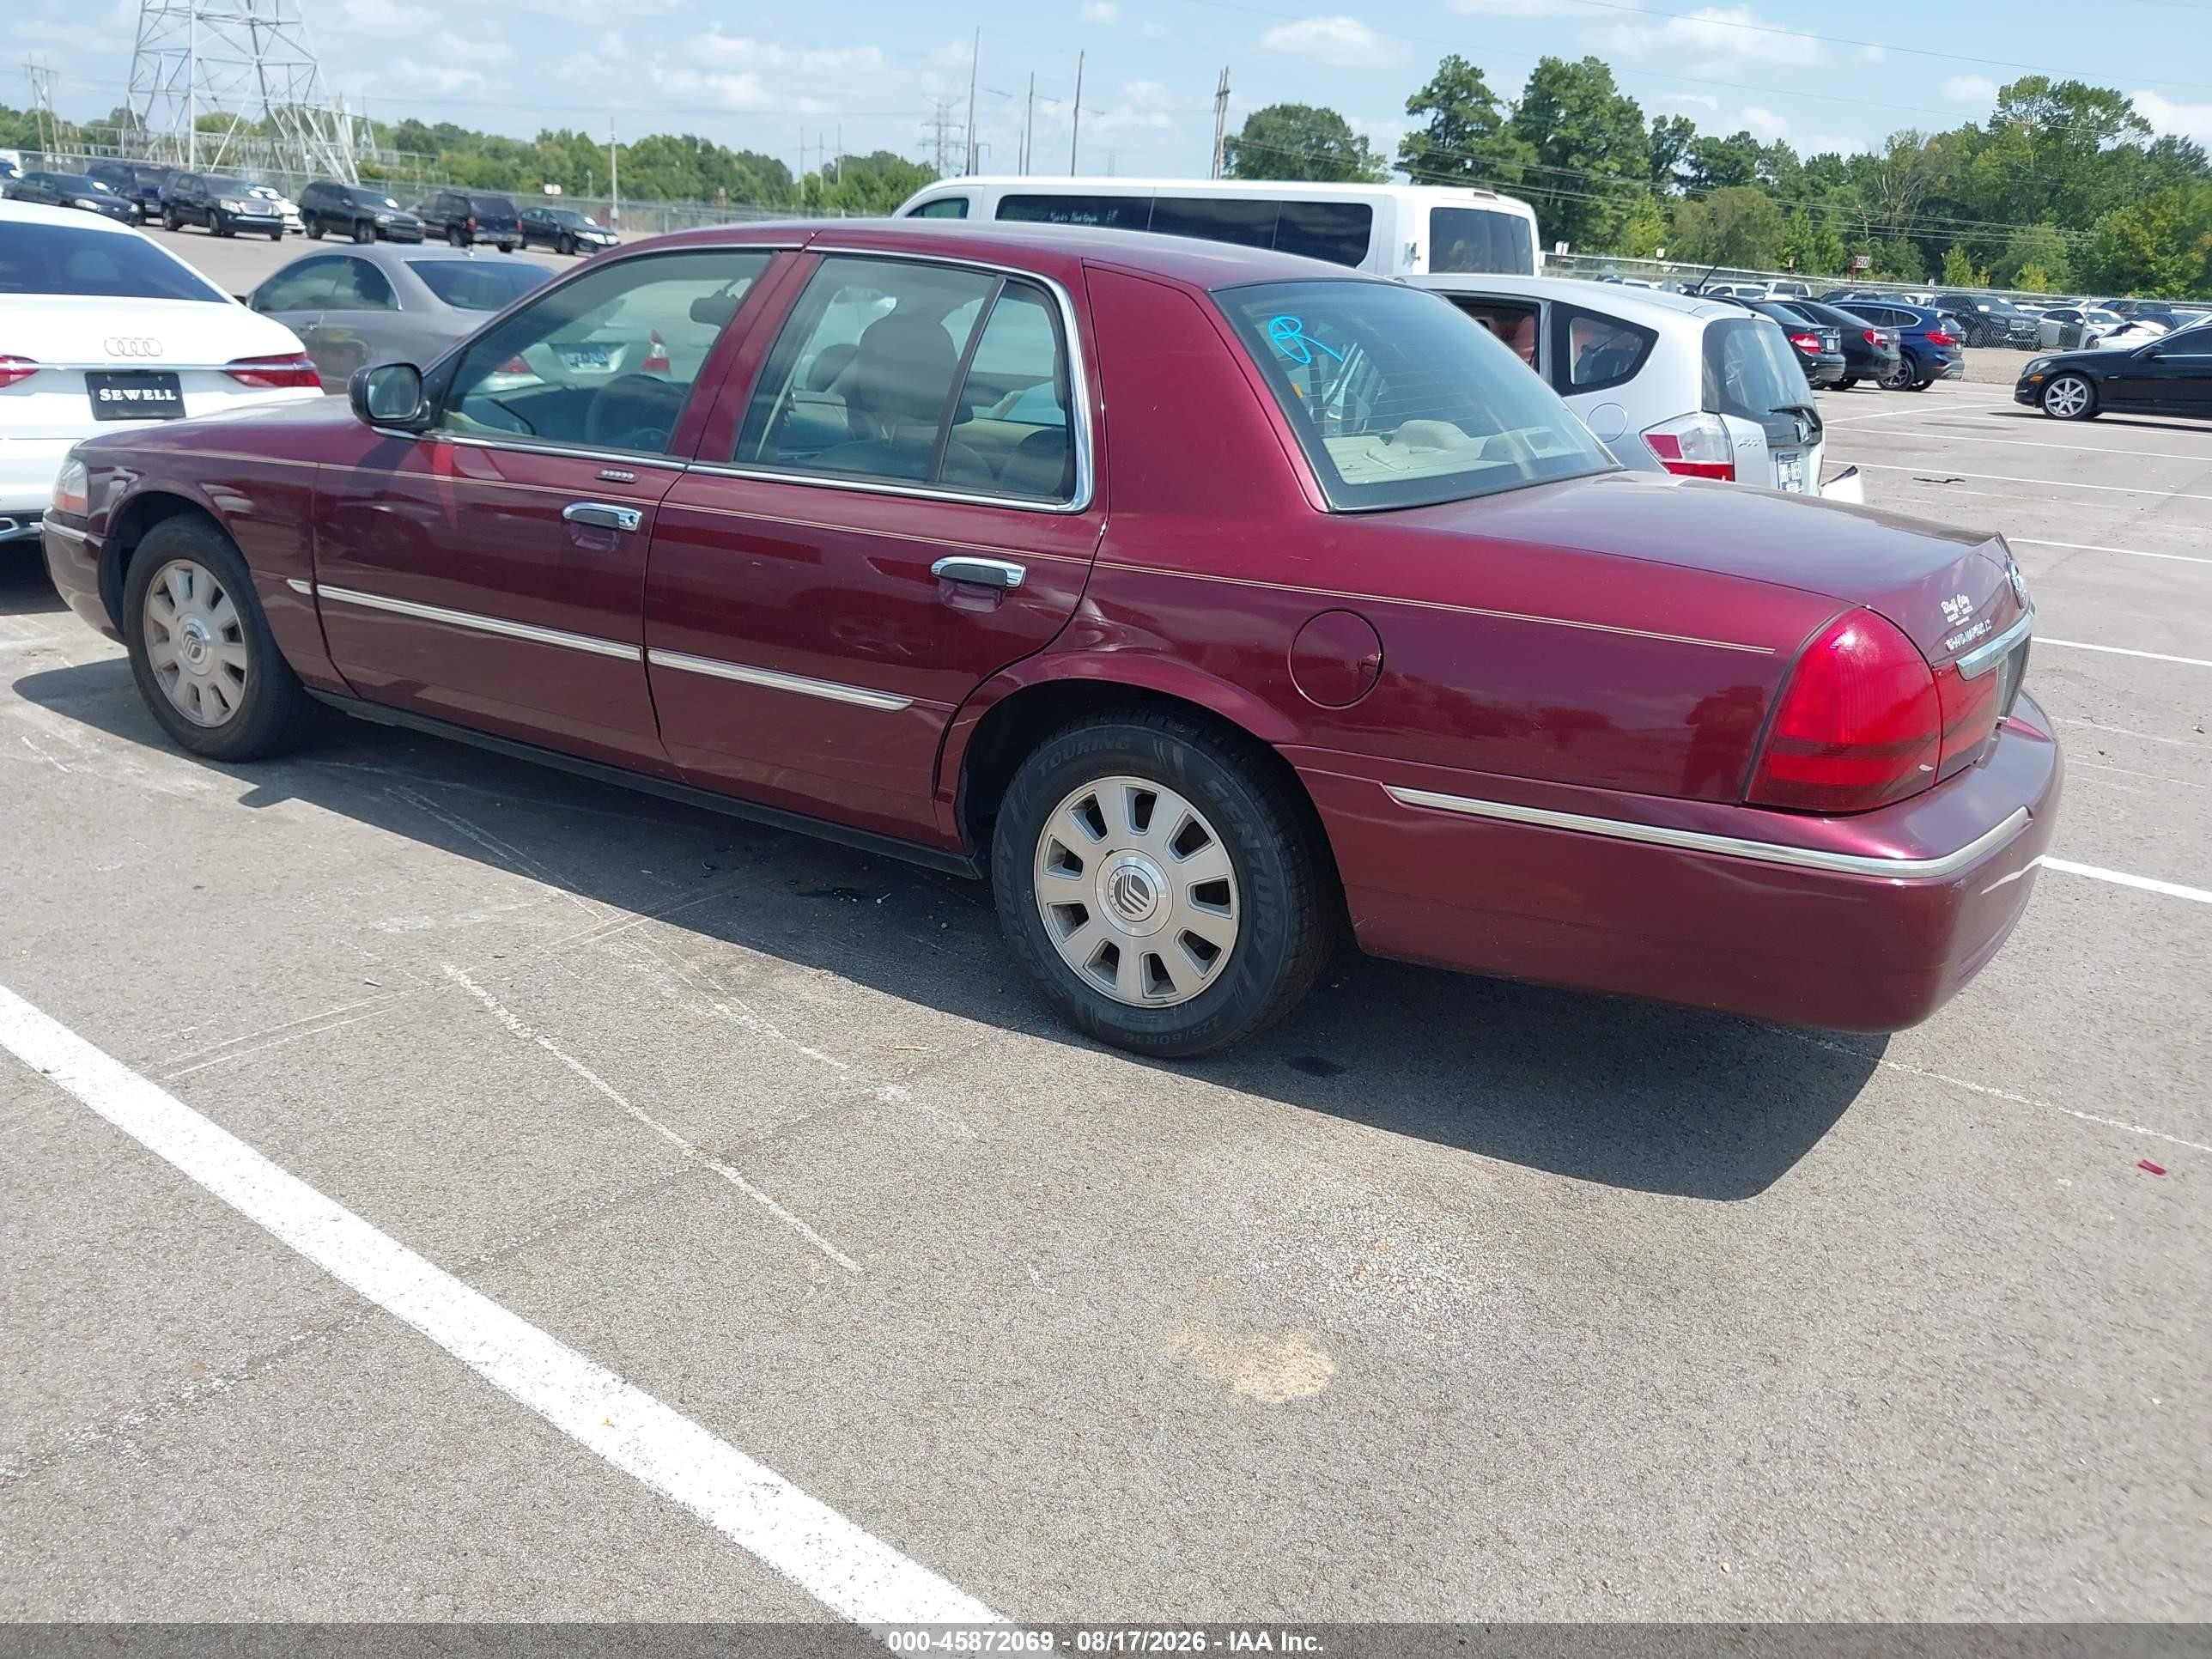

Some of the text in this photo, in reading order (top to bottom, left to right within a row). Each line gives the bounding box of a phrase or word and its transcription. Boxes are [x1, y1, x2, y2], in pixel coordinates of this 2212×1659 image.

[1857, 258, 1869, 267] 50
[99, 388, 177, 402] SEWELL
[1037, 737, 1131, 776] TOURING
